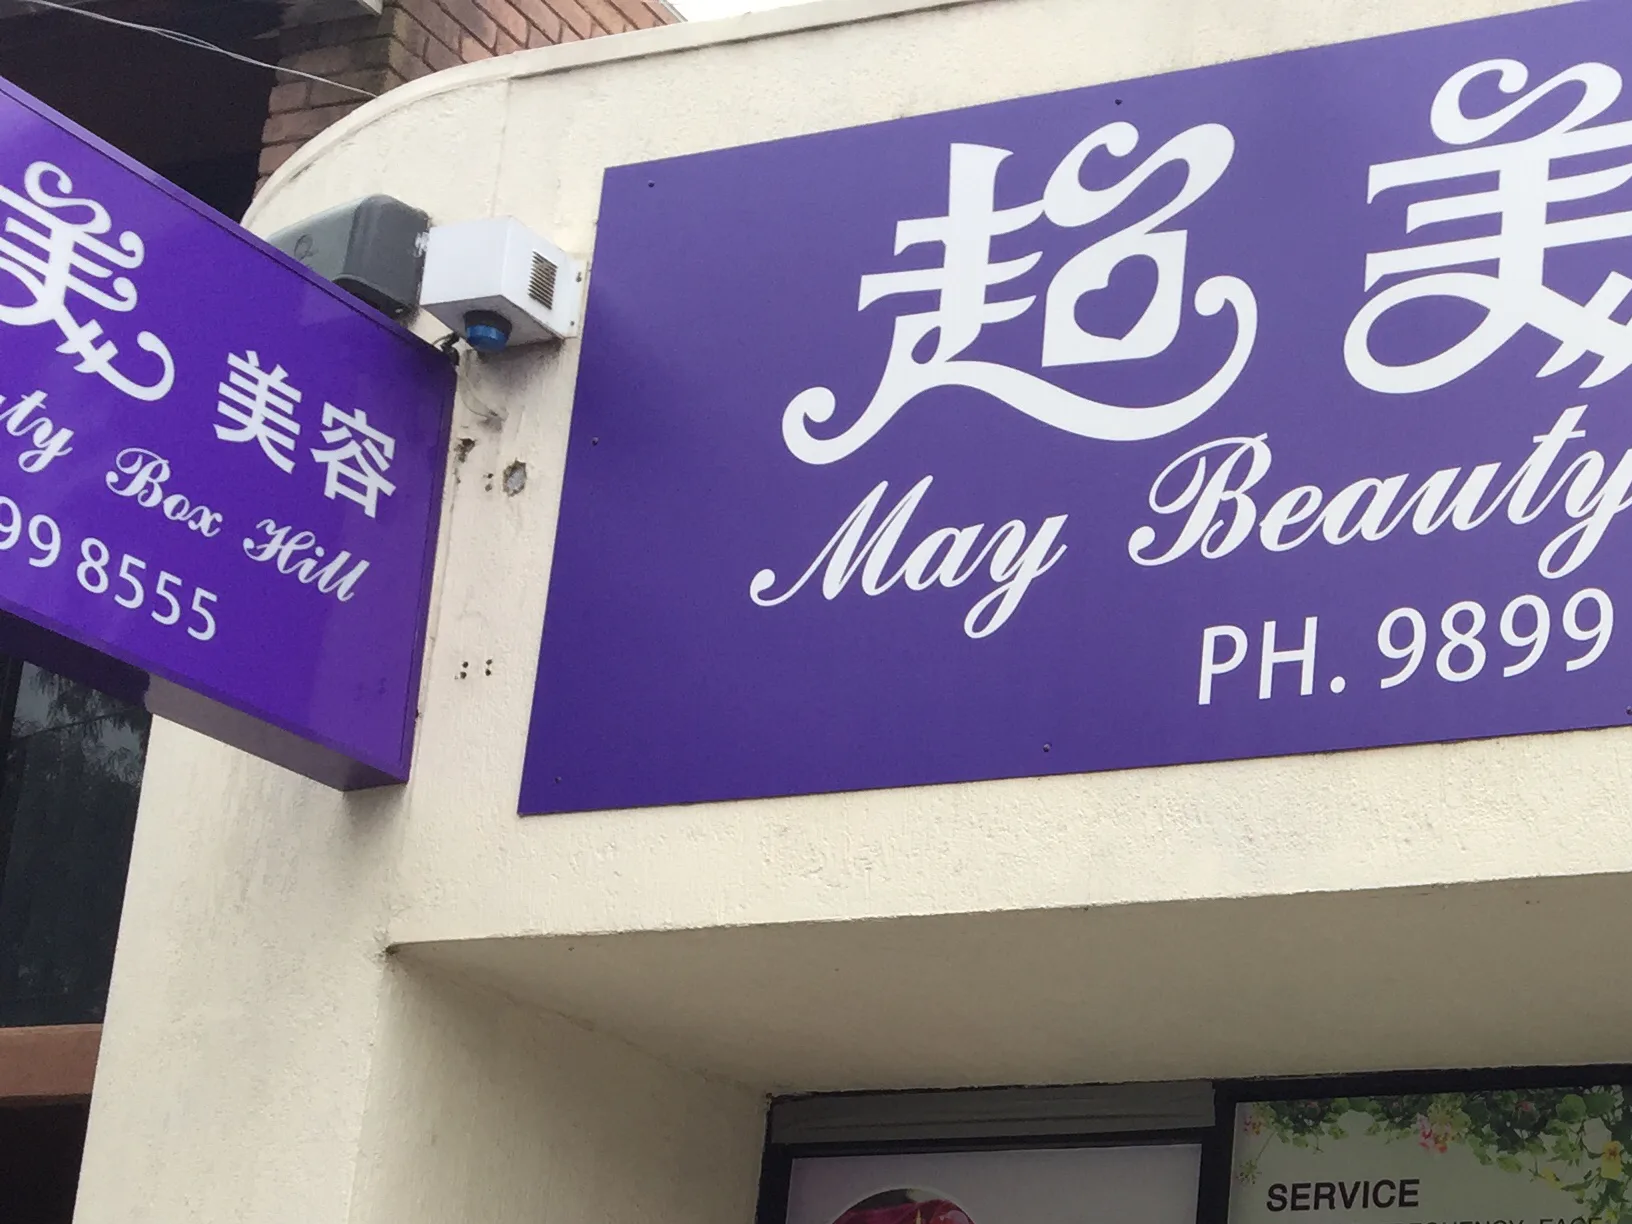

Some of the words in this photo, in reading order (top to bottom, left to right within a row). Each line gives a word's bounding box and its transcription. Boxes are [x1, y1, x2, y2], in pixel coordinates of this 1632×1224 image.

[215, 351, 397, 518] 美容
[76, 537, 217, 641] 8555
[106, 448, 223, 537] Box
[243, 519, 370, 601] Hill
[750, 475, 1069, 639] May
[1198, 616, 1346, 705] PH.
[1377, 587, 1614, 689] 9899
[1266, 1179, 1420, 1212] SERVICE
